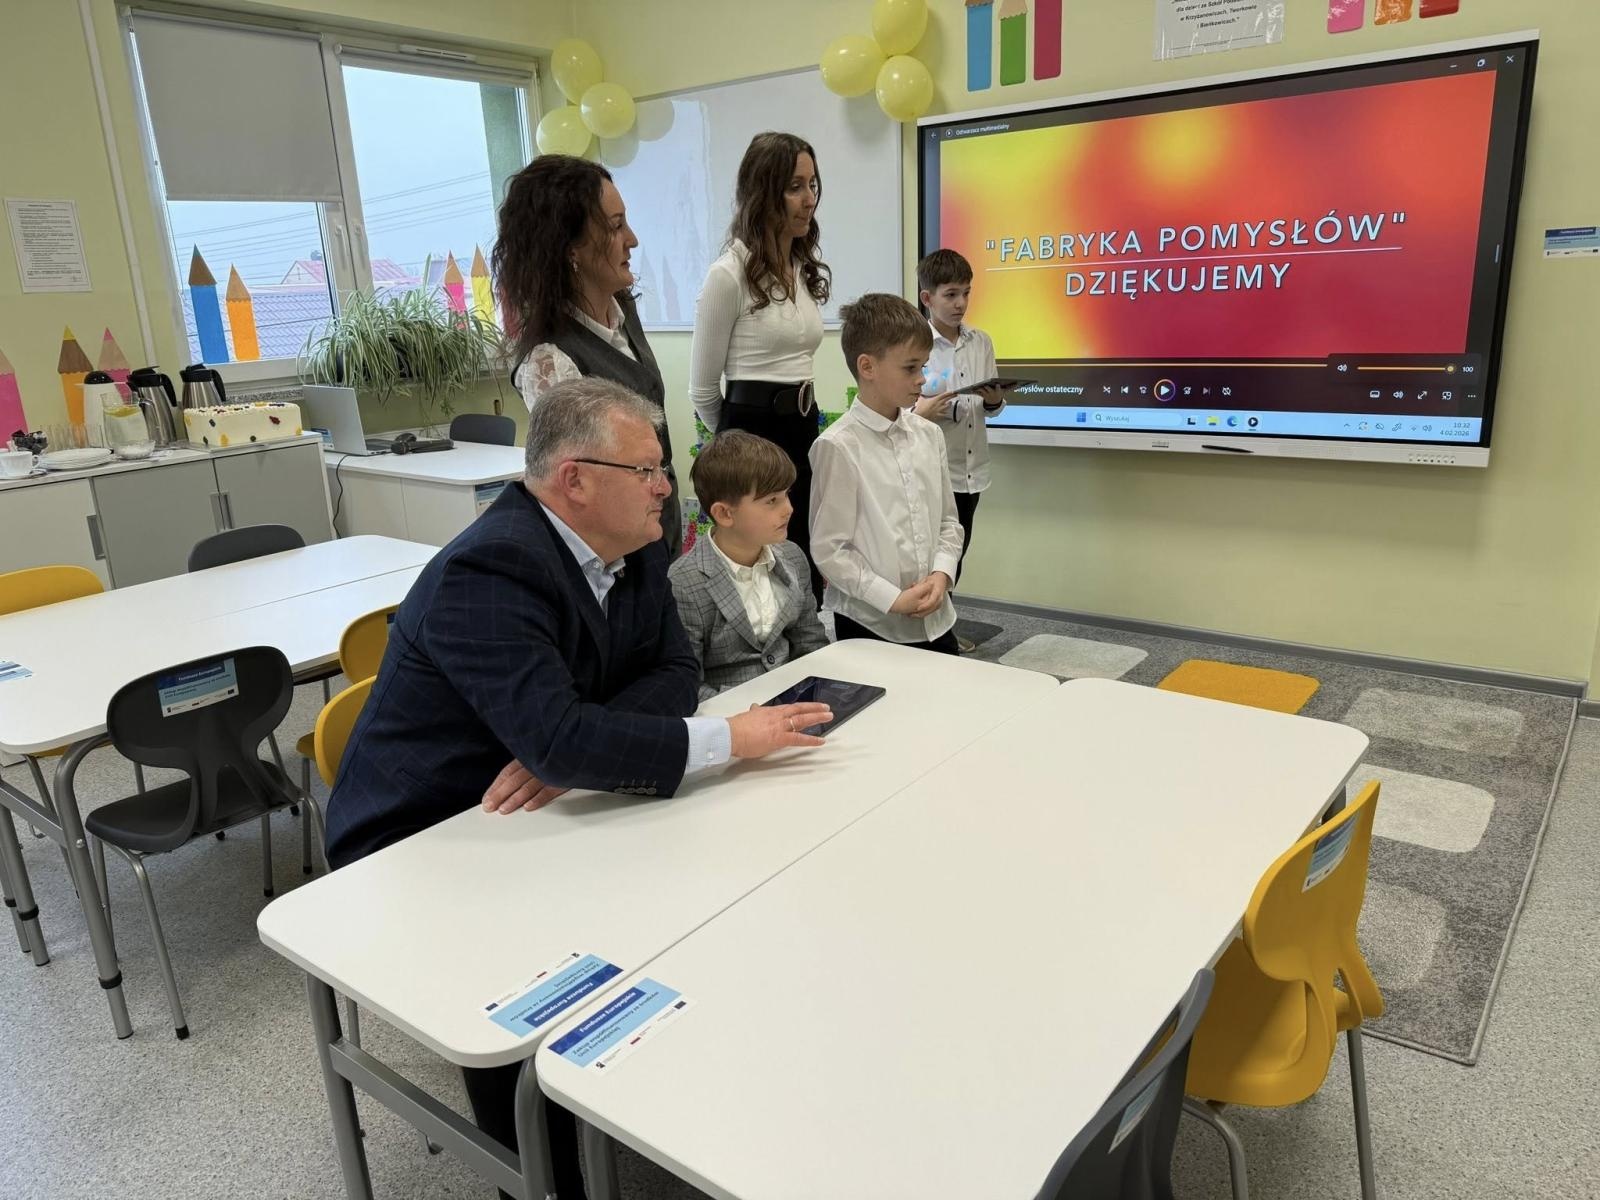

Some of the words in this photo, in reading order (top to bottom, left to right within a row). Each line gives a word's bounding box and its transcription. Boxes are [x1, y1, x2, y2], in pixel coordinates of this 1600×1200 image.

[985, 230, 1143, 262] "FABRYKA
[1158, 210, 1407, 253] POMYSŁÓW"
[1064, 262, 1292, 300] DZIĘKUJEMY
[1045, 385, 1084, 395] ostateczny
